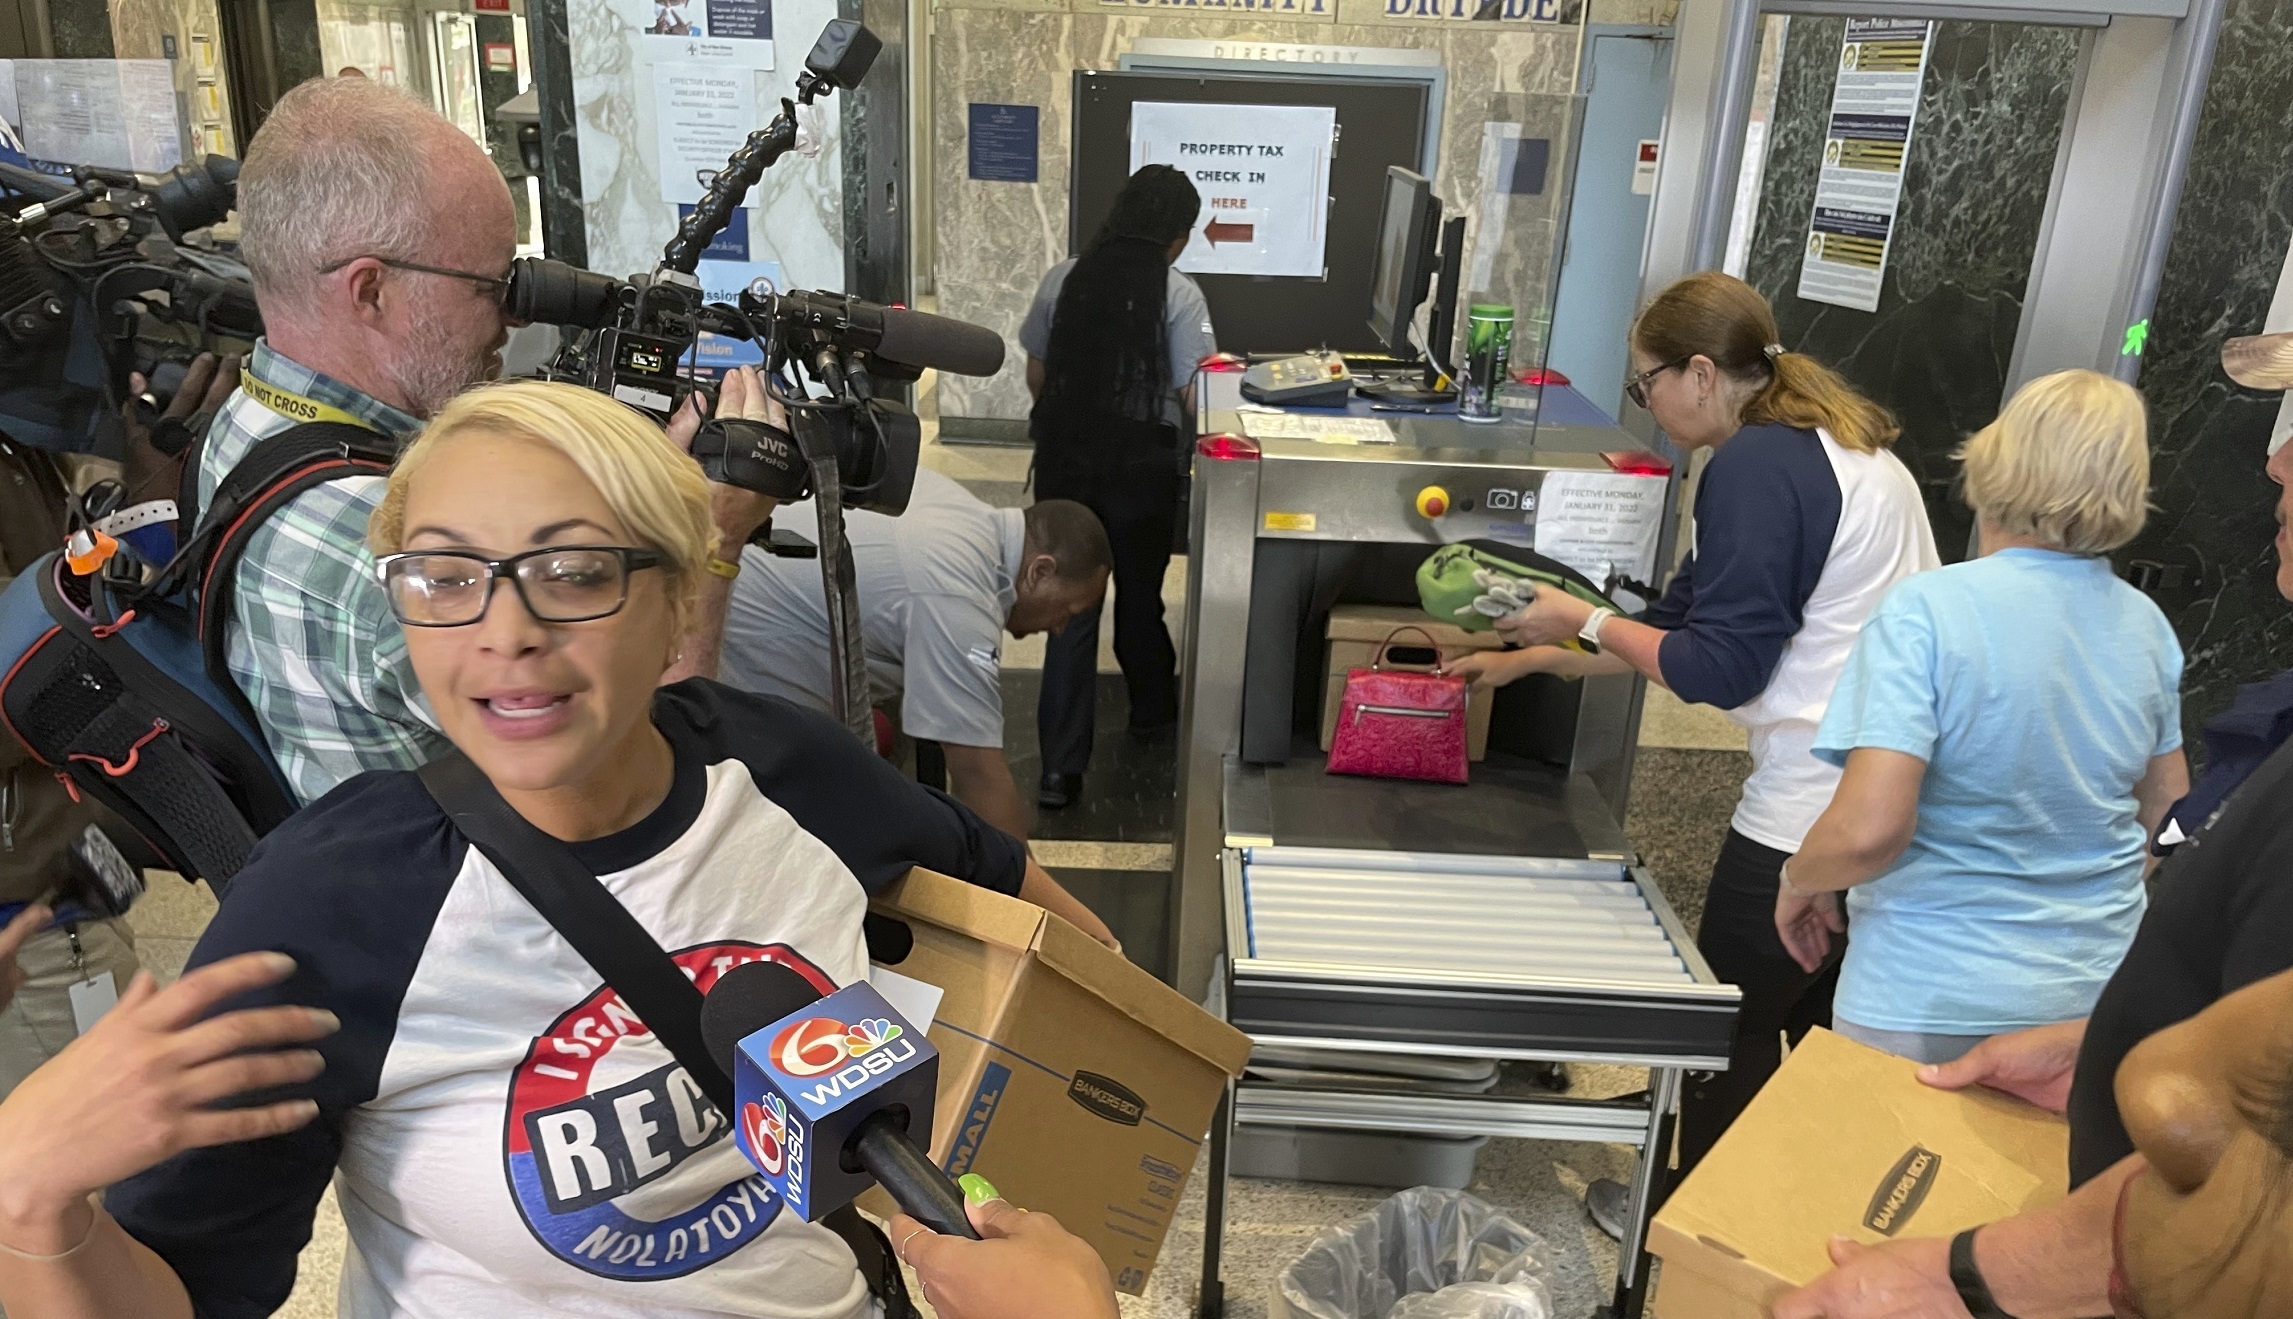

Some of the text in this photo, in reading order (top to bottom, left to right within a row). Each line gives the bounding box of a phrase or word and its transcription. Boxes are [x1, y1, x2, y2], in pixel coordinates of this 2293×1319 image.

[1214, 45, 1359, 63] DIRECTORY
[1180, 142, 1284, 157] PROPERTY TAX
[1195, 170, 1266, 183] CHECK IN
[1211, 198, 1247, 209] HERE
[254, 384, 272, 404] NOT
[274, 395, 318, 419] CROSS
[757, 436, 788, 458] JVC
[1561, 488, 1603, 497] EFFECTIVE
[1564, 502, 1602, 511] JANUARY
[782, 1020, 850, 1076] 6
[801, 1038, 917, 1106] WDSU
[1119, 1099, 1142, 1120] BOX
[537, 1066, 719, 1201] REC
[744, 1106, 783, 1174] 6
[948, 1089, 998, 1191] MALL
[786, 1113, 804, 1205] WDSU
[1872, 1152, 1932, 1230] BANKERS BOX
